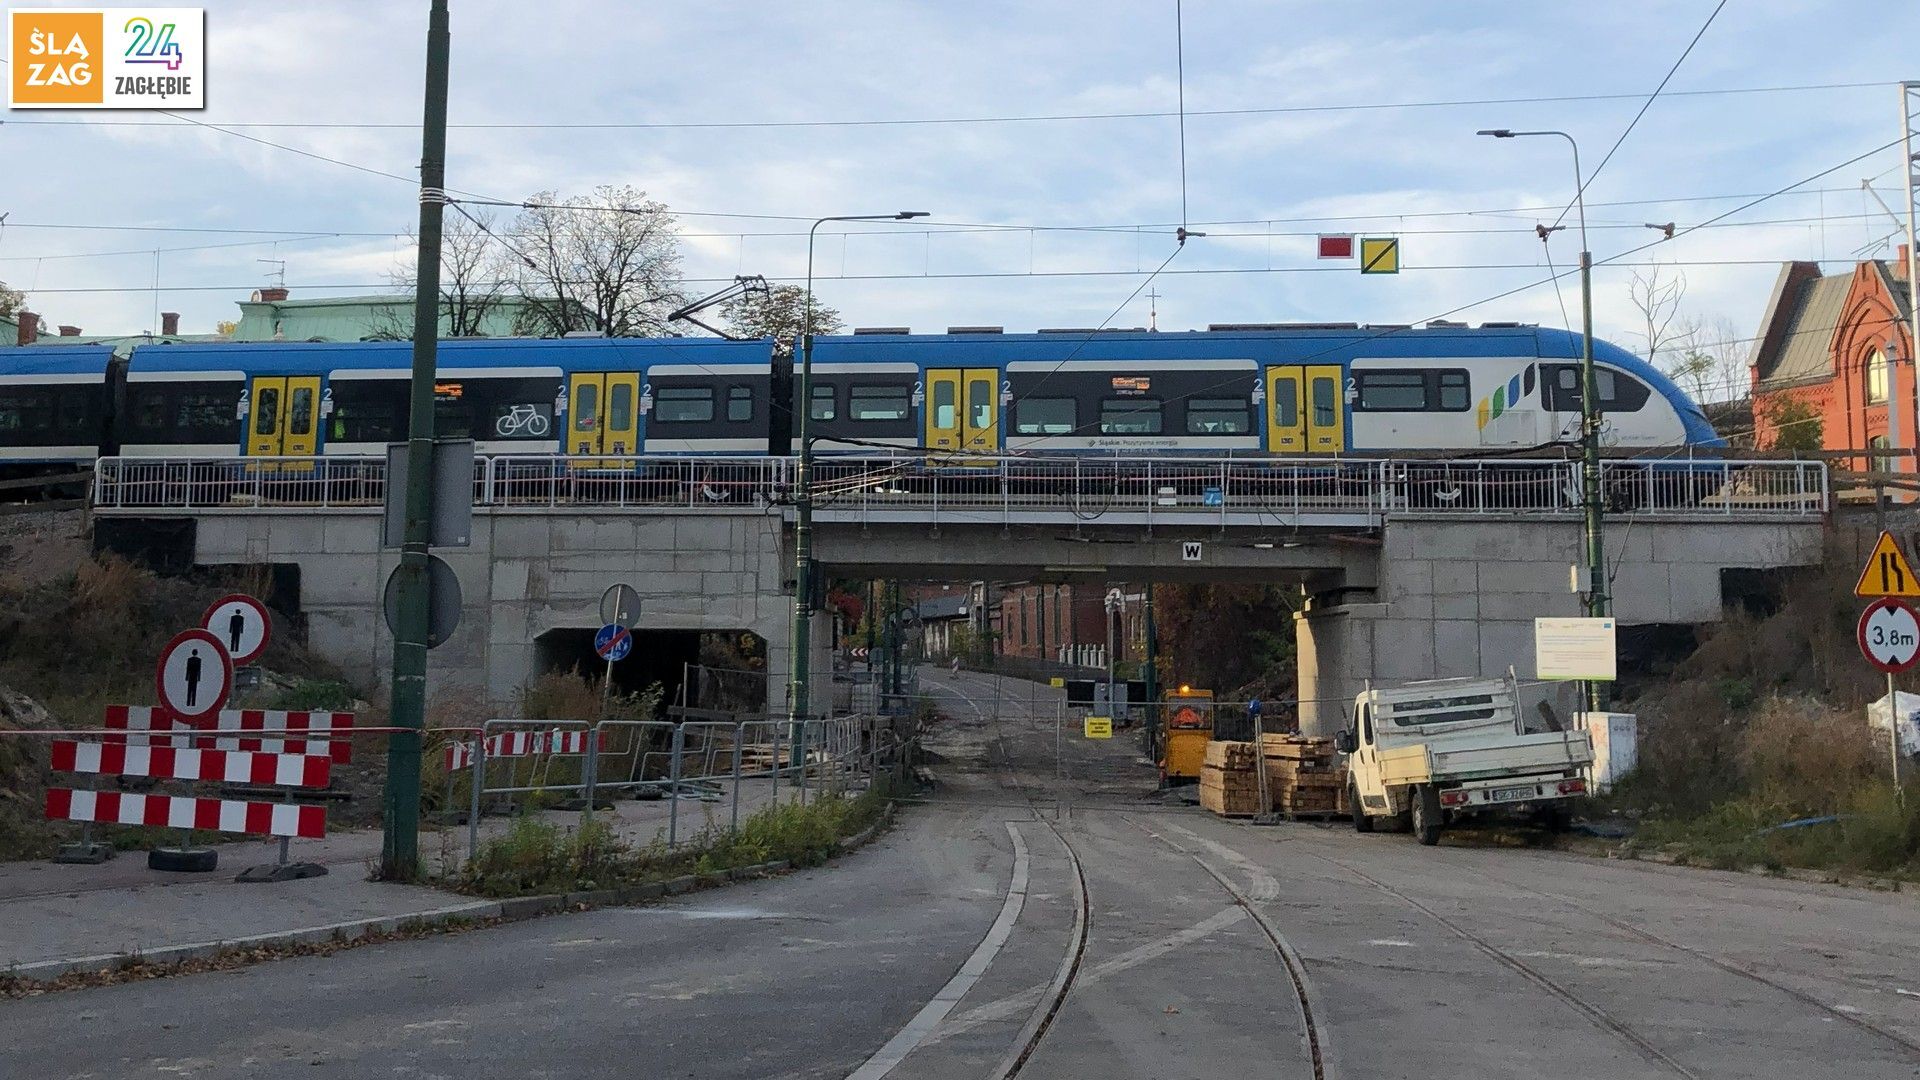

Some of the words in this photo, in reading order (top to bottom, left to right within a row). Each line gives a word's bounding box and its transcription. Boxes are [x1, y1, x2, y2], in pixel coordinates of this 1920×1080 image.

[914, 381, 923, 393] 2
[1002, 380, 1011, 393] 2
[1253, 379, 1263, 391] 2
[1346, 377, 1356, 390] 2
[240, 389, 249, 401] 2
[323, 388, 333, 400] 2
[558, 385, 566, 397] 2
[643, 384, 651, 396] 2
[1185, 545, 1199, 557] W
[1873, 625, 1914, 647] 3,8m
